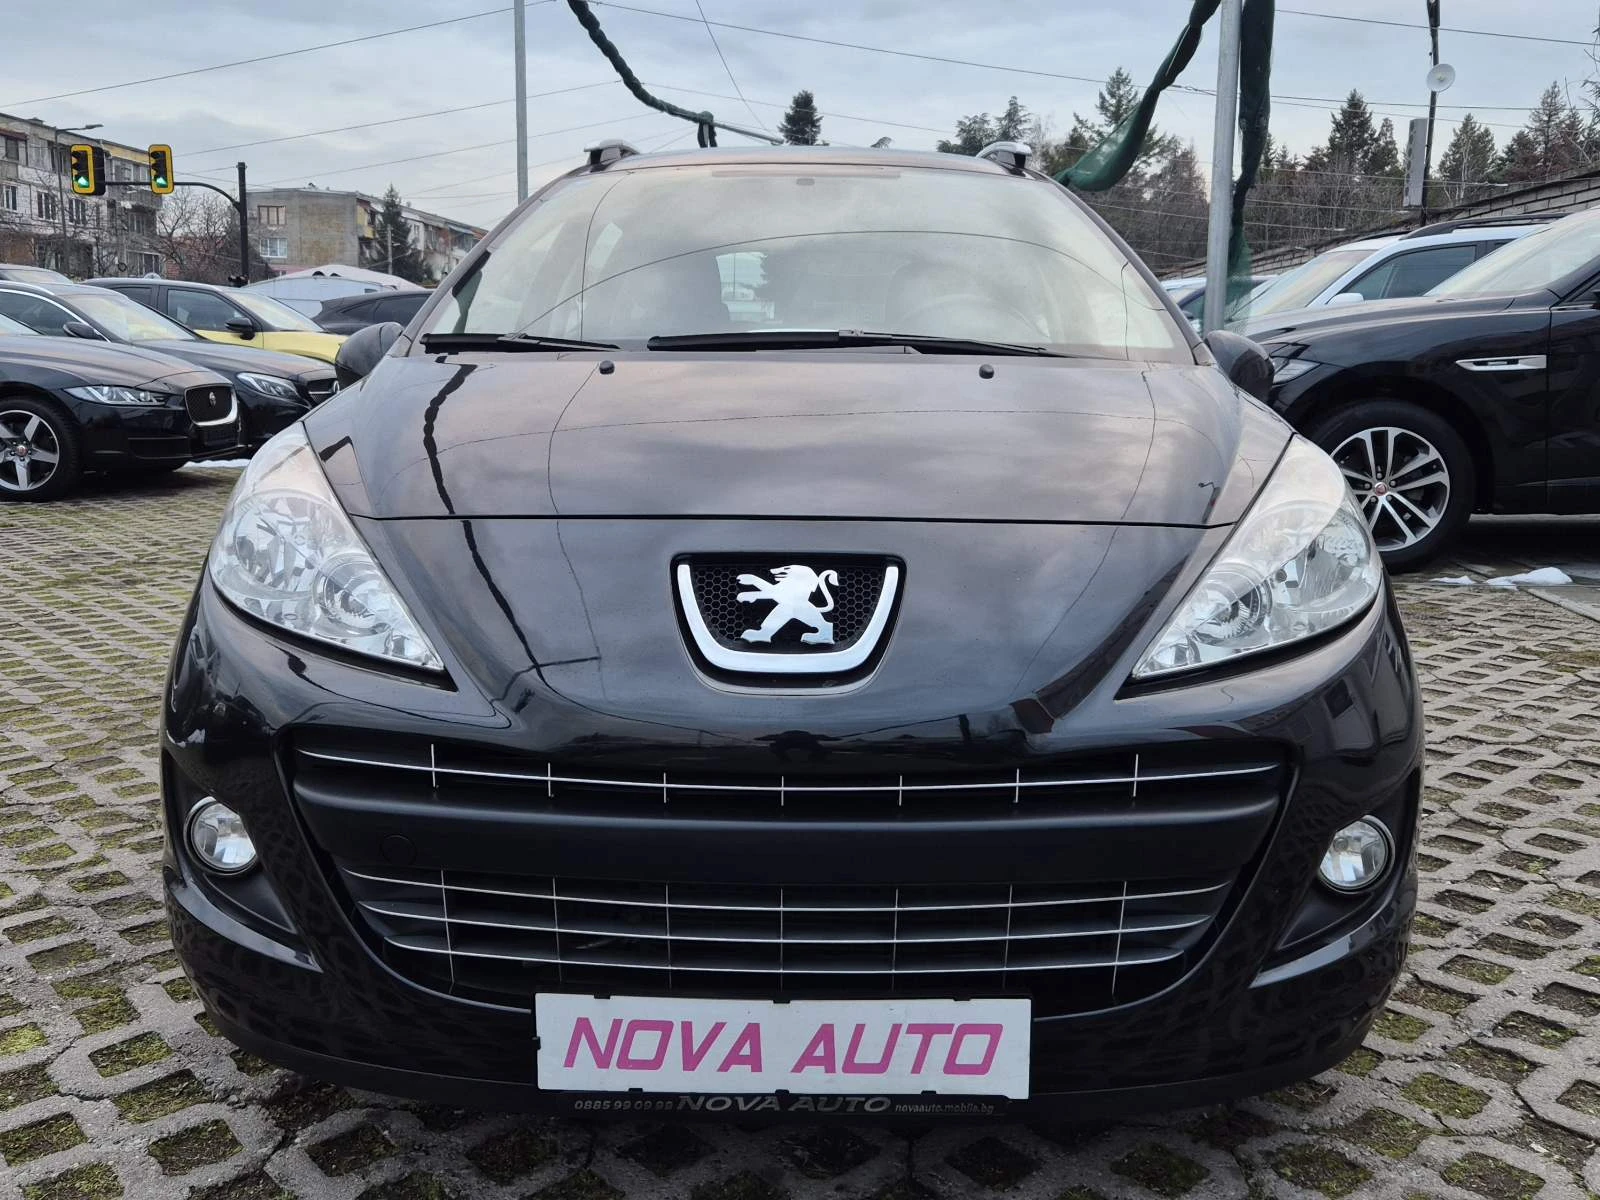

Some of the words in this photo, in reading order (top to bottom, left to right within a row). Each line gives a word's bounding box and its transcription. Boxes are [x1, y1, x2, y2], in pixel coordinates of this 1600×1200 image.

[563, 1017, 763, 1073] NOVA
[791, 1023, 1003, 1075] AUTO
[574, 1100, 611, 1111] 0885
[676, 1095, 781, 1112] NOVA
[788, 1096, 891, 1112] AUTO
